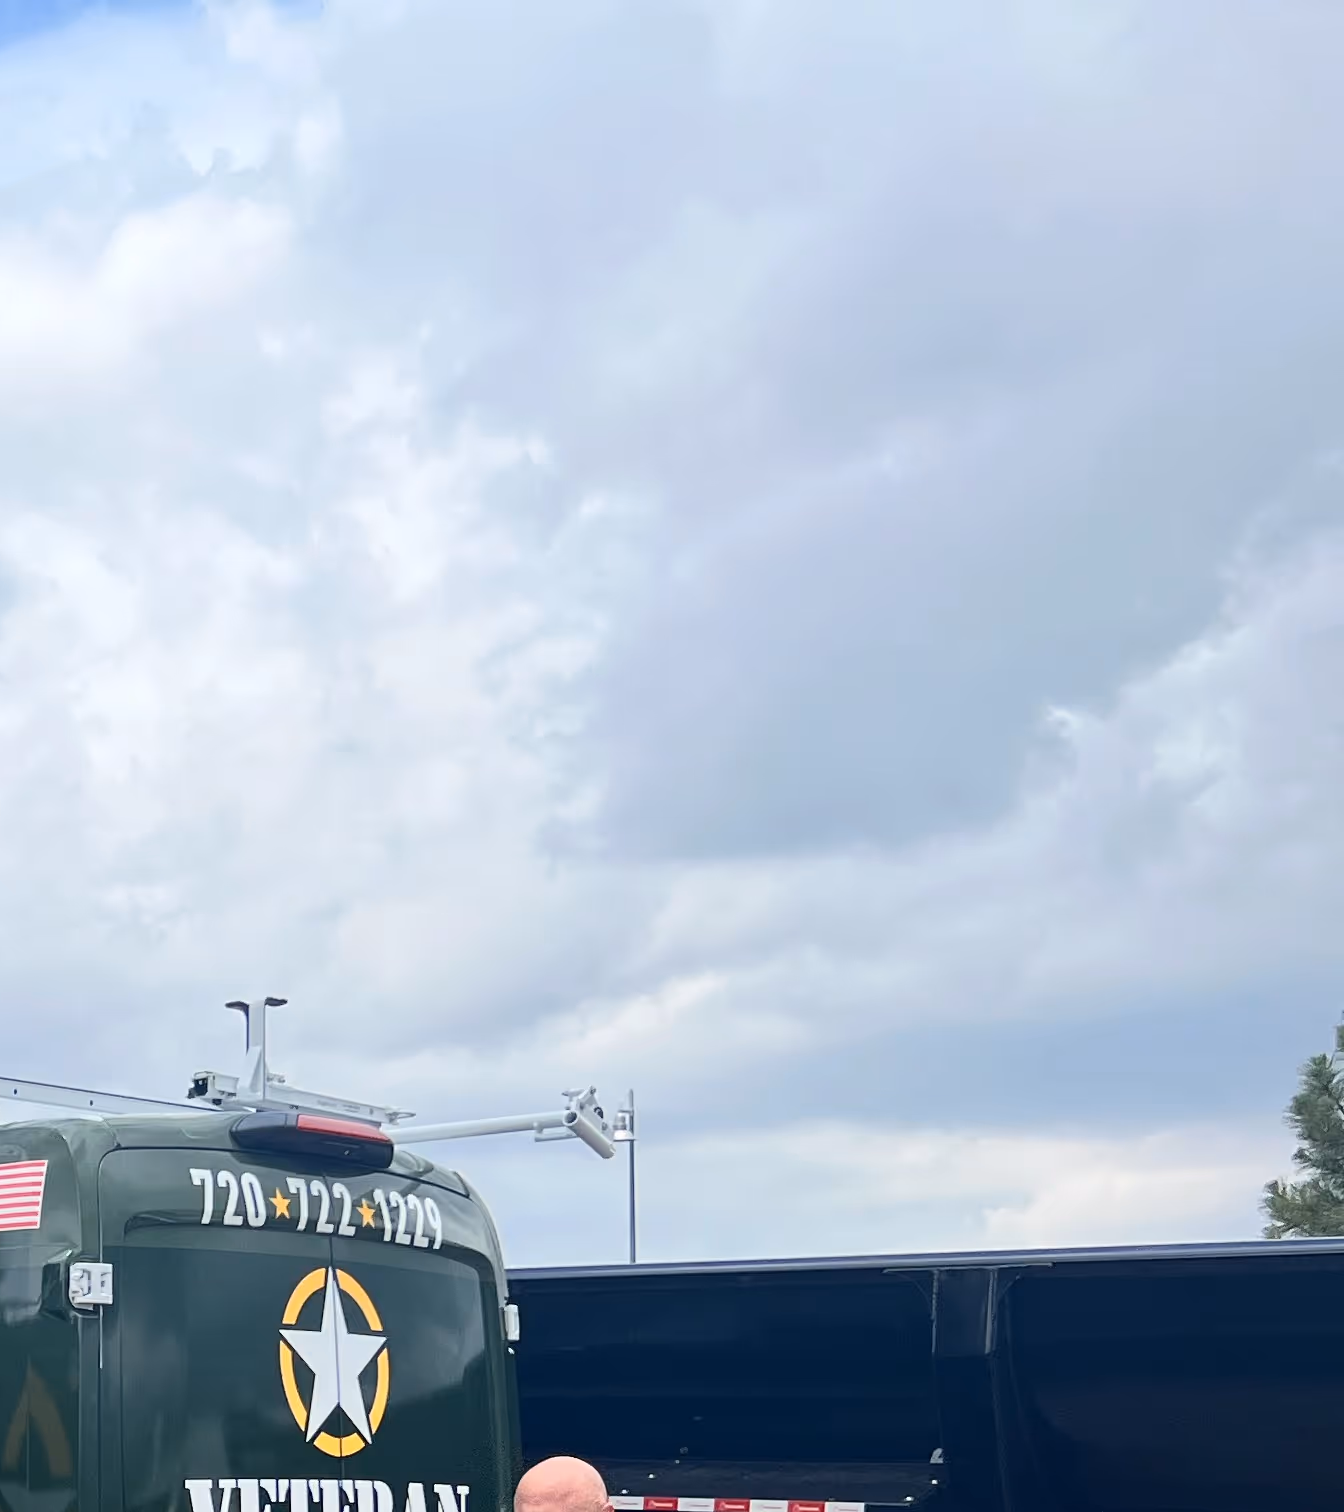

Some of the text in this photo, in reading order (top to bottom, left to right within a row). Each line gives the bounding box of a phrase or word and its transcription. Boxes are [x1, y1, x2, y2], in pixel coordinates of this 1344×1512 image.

[189, 1168, 443, 1250] 720 722 1229
